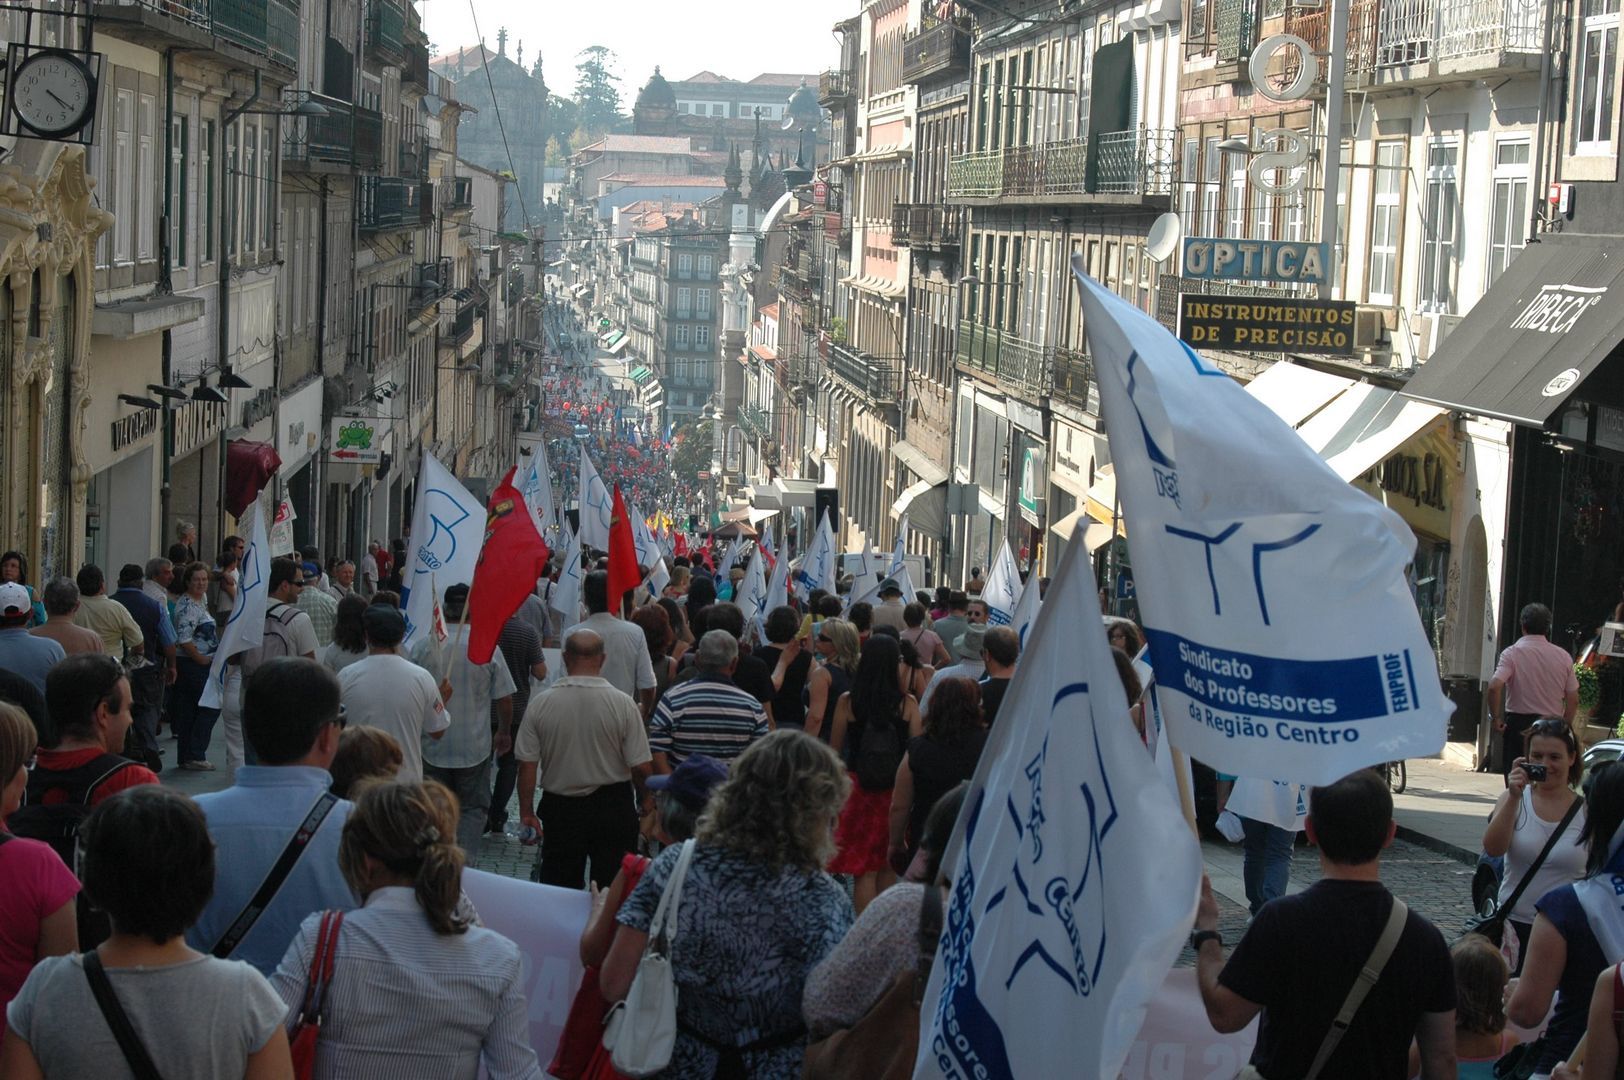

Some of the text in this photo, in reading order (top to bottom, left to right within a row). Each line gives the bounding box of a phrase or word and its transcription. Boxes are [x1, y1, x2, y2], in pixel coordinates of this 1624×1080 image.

[38, 65, 46, 77] 11
[49, 64, 60, 74] 12
[64, 69, 68, 78] 1
[28, 75, 39, 86] 10
[71, 79, 78, 88] 2
[23, 86, 30, 94] 9
[73, 92, 81, 101] 3
[45, 114, 53, 123] 6
[60, 111, 67, 121] 5
[1186, 302, 1354, 326] INSTRUMENTOS
[1510, 284, 1607, 334] TRIBECA
[1191, 325, 1348, 348] DE PRECISÃO
[1178, 641, 1253, 680] Sindicato
[1382, 652, 1411, 714] FENPROF
[1184, 669, 1338, 715] dos Professores
[1188, 701, 1203, 722] da
[1205, 713, 1269, 740] Região
[1275, 721, 1360, 745] Centro
